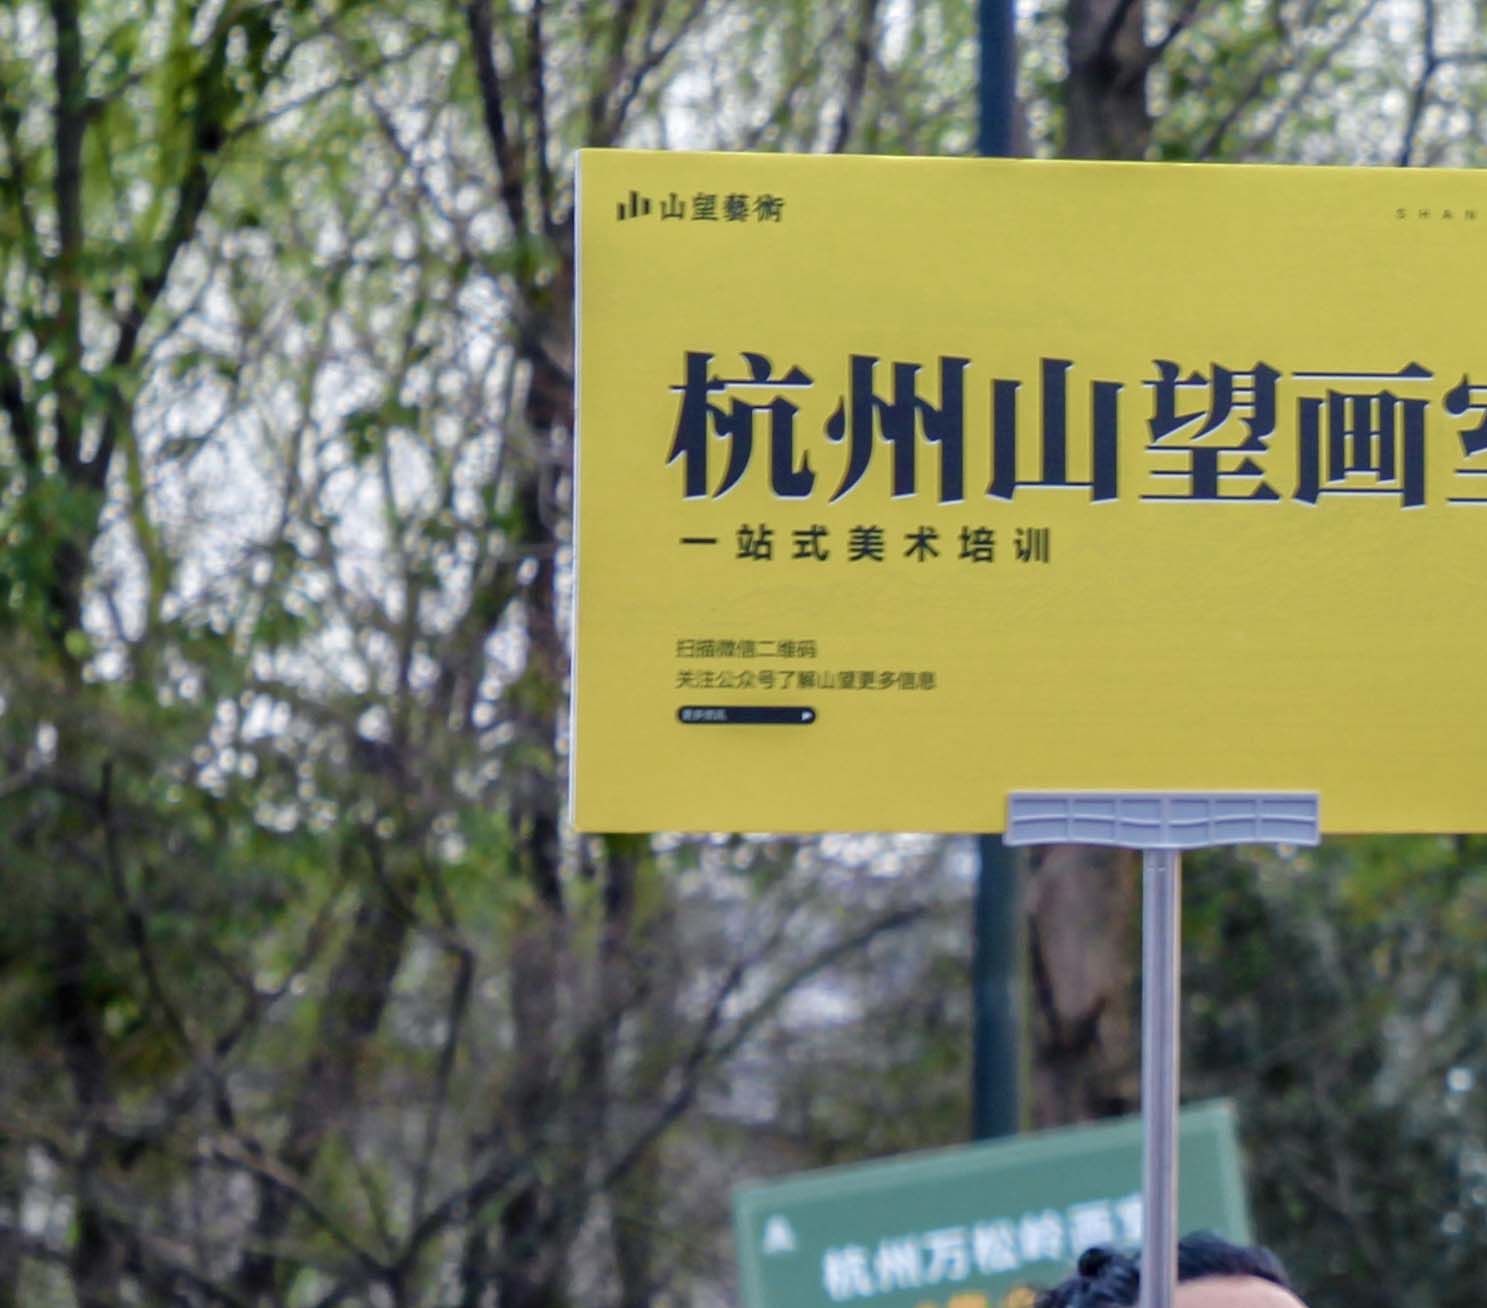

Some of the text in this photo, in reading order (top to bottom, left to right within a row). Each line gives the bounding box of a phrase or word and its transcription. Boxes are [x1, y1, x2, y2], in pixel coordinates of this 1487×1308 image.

[660, 192, 785, 222] 山望藝術
[679, 523, 1052, 564] 一站式美术培训
[676, 639, 817, 659] 扫描微信二维码
[676, 669, 936, 691] 关注公众号了解山望更多信息
